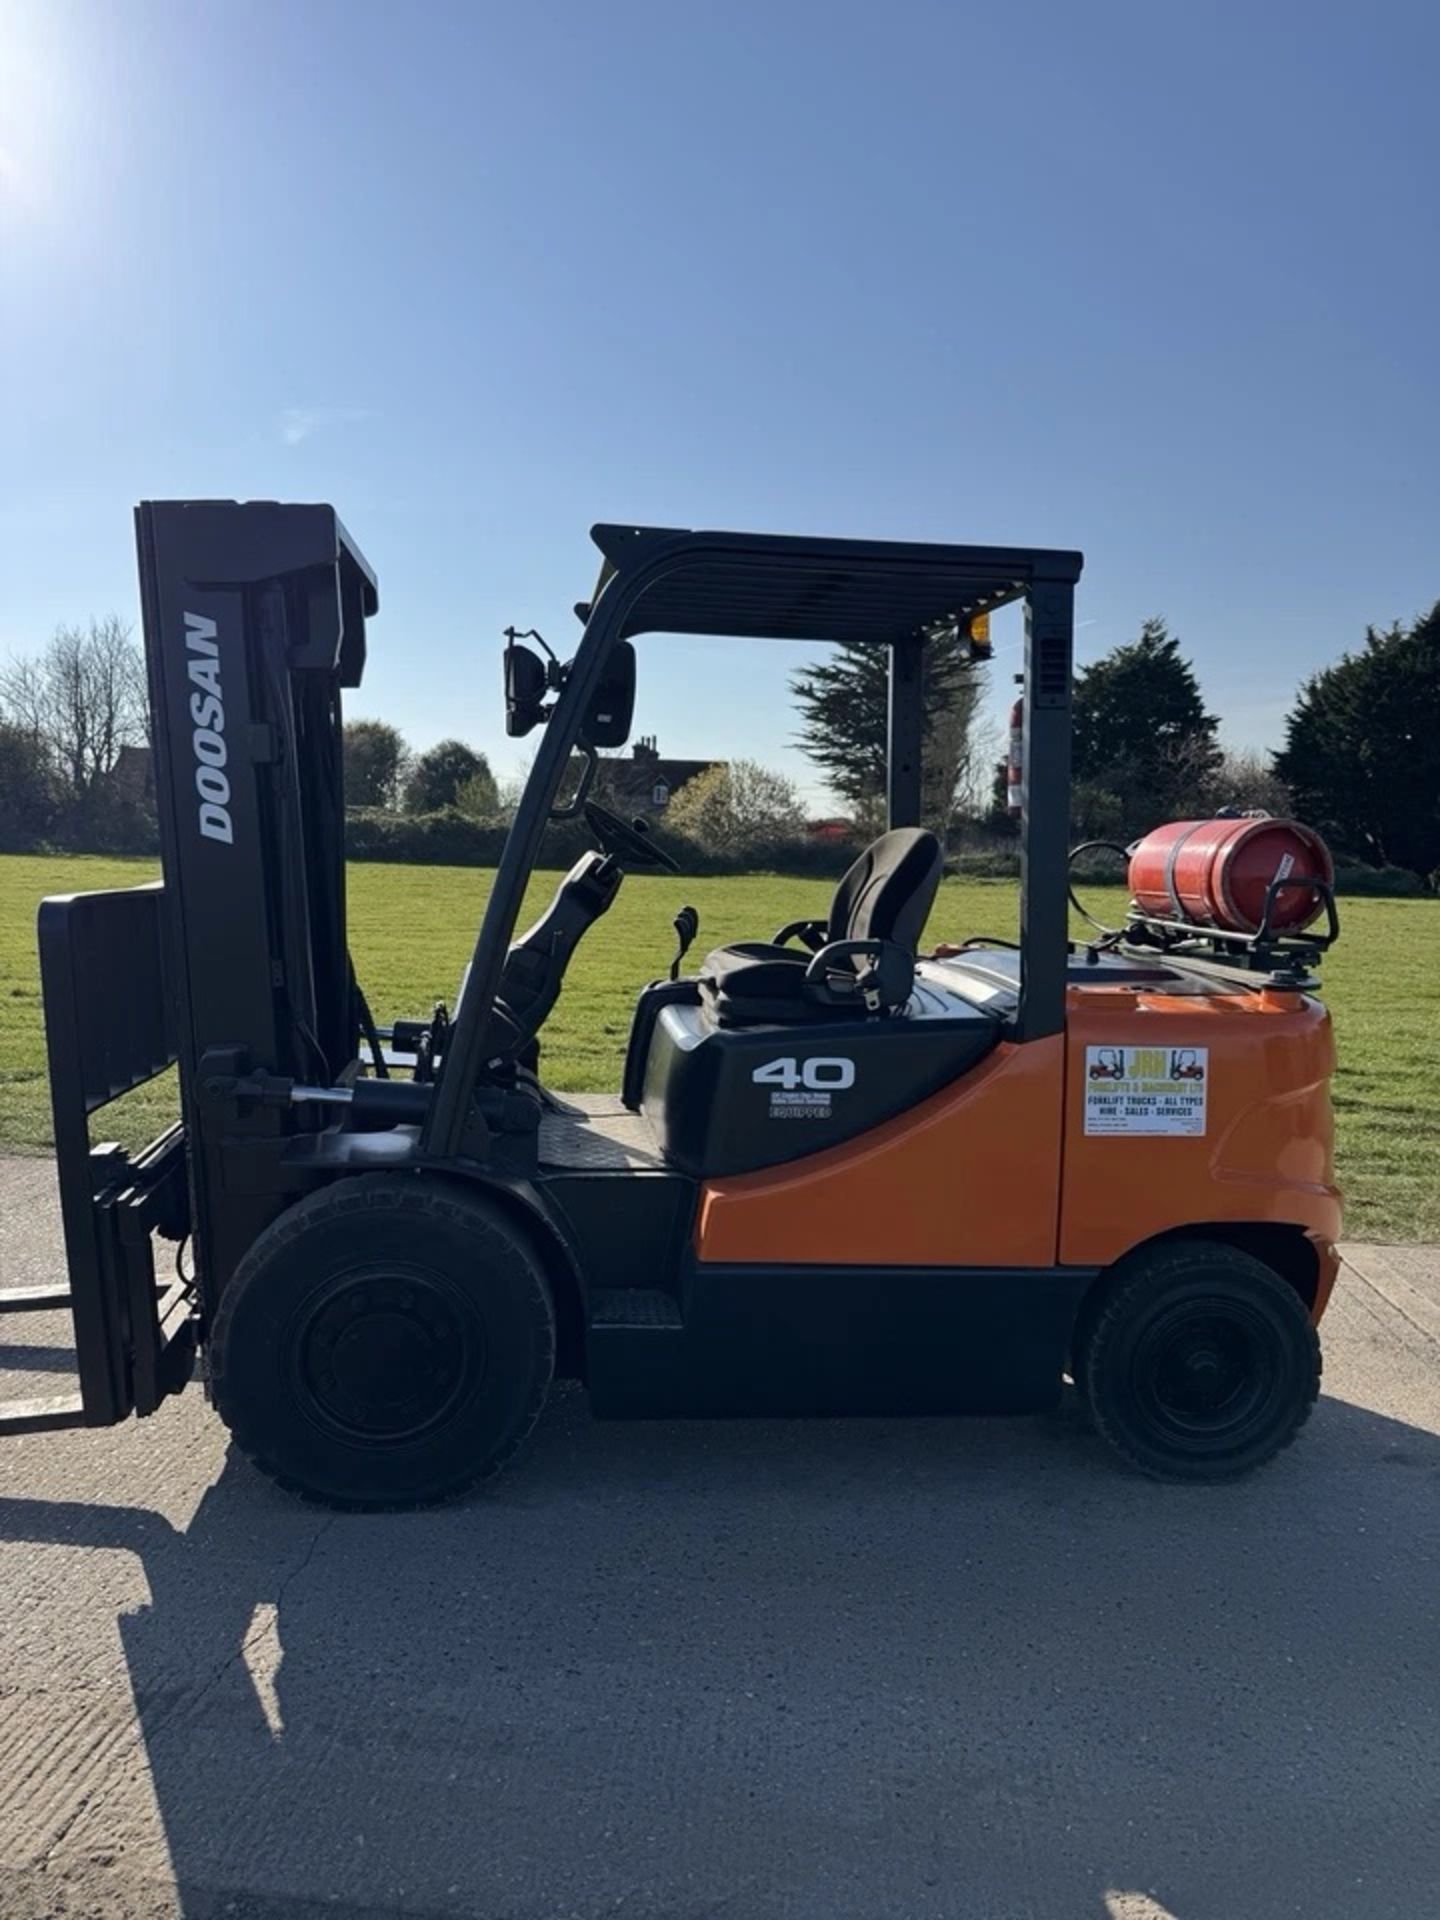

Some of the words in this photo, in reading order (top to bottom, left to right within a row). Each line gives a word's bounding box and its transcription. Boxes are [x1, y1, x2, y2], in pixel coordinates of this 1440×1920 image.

[183, 611, 234, 844] DOOSAN
[752, 1056, 855, 1089] 40
[1088, 1096, 1124, 1105] FORKLIFT
[1127, 1096, 1157, 1106] TRUCKS
[1164, 1096, 1178, 1106] ALL
[1180, 1096, 1203, 1107] TYPES
[769, 1106, 832, 1118] EQUIPPED
[1100, 1106, 1117, 1116] HIRE
[1125, 1106, 1149, 1116] SALES
[1156, 1107, 1193, 1117] SERVICES
